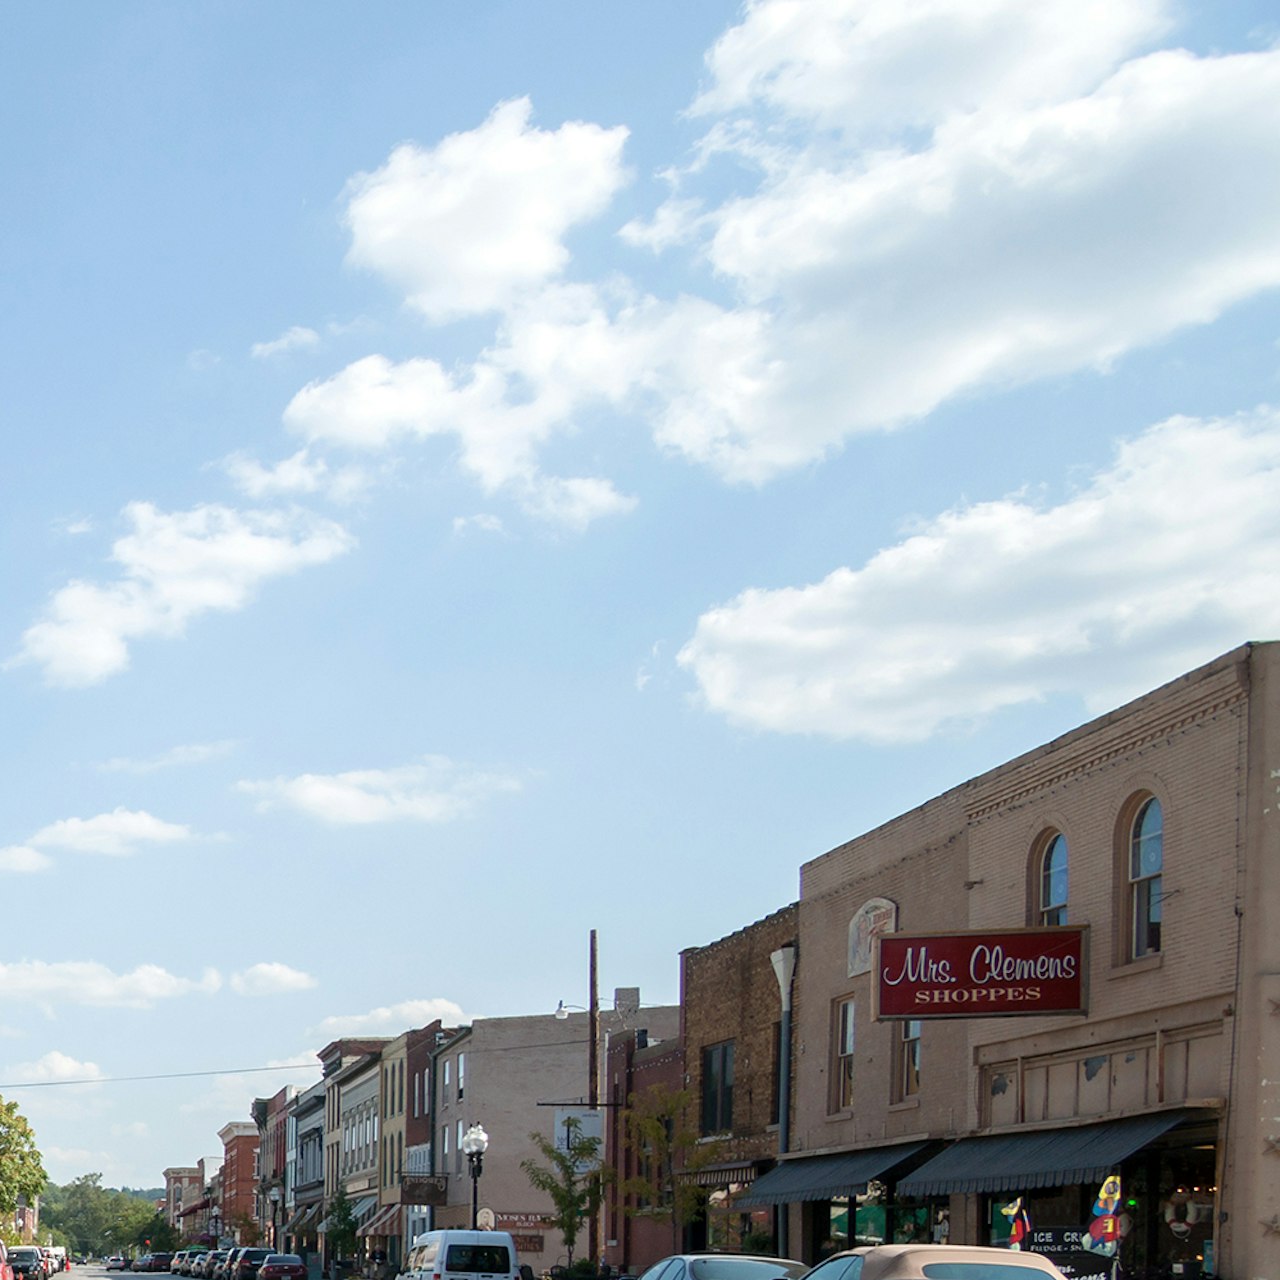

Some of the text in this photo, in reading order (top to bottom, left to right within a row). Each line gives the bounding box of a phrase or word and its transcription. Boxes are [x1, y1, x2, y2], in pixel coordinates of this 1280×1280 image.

[883, 944, 1076, 985] Mrs. Clemens
[914, 987, 1041, 1004] SHOPPES
[1033, 1232, 1054, 1242] ICE
[1030, 1244, 1063, 1252] FUDGE
